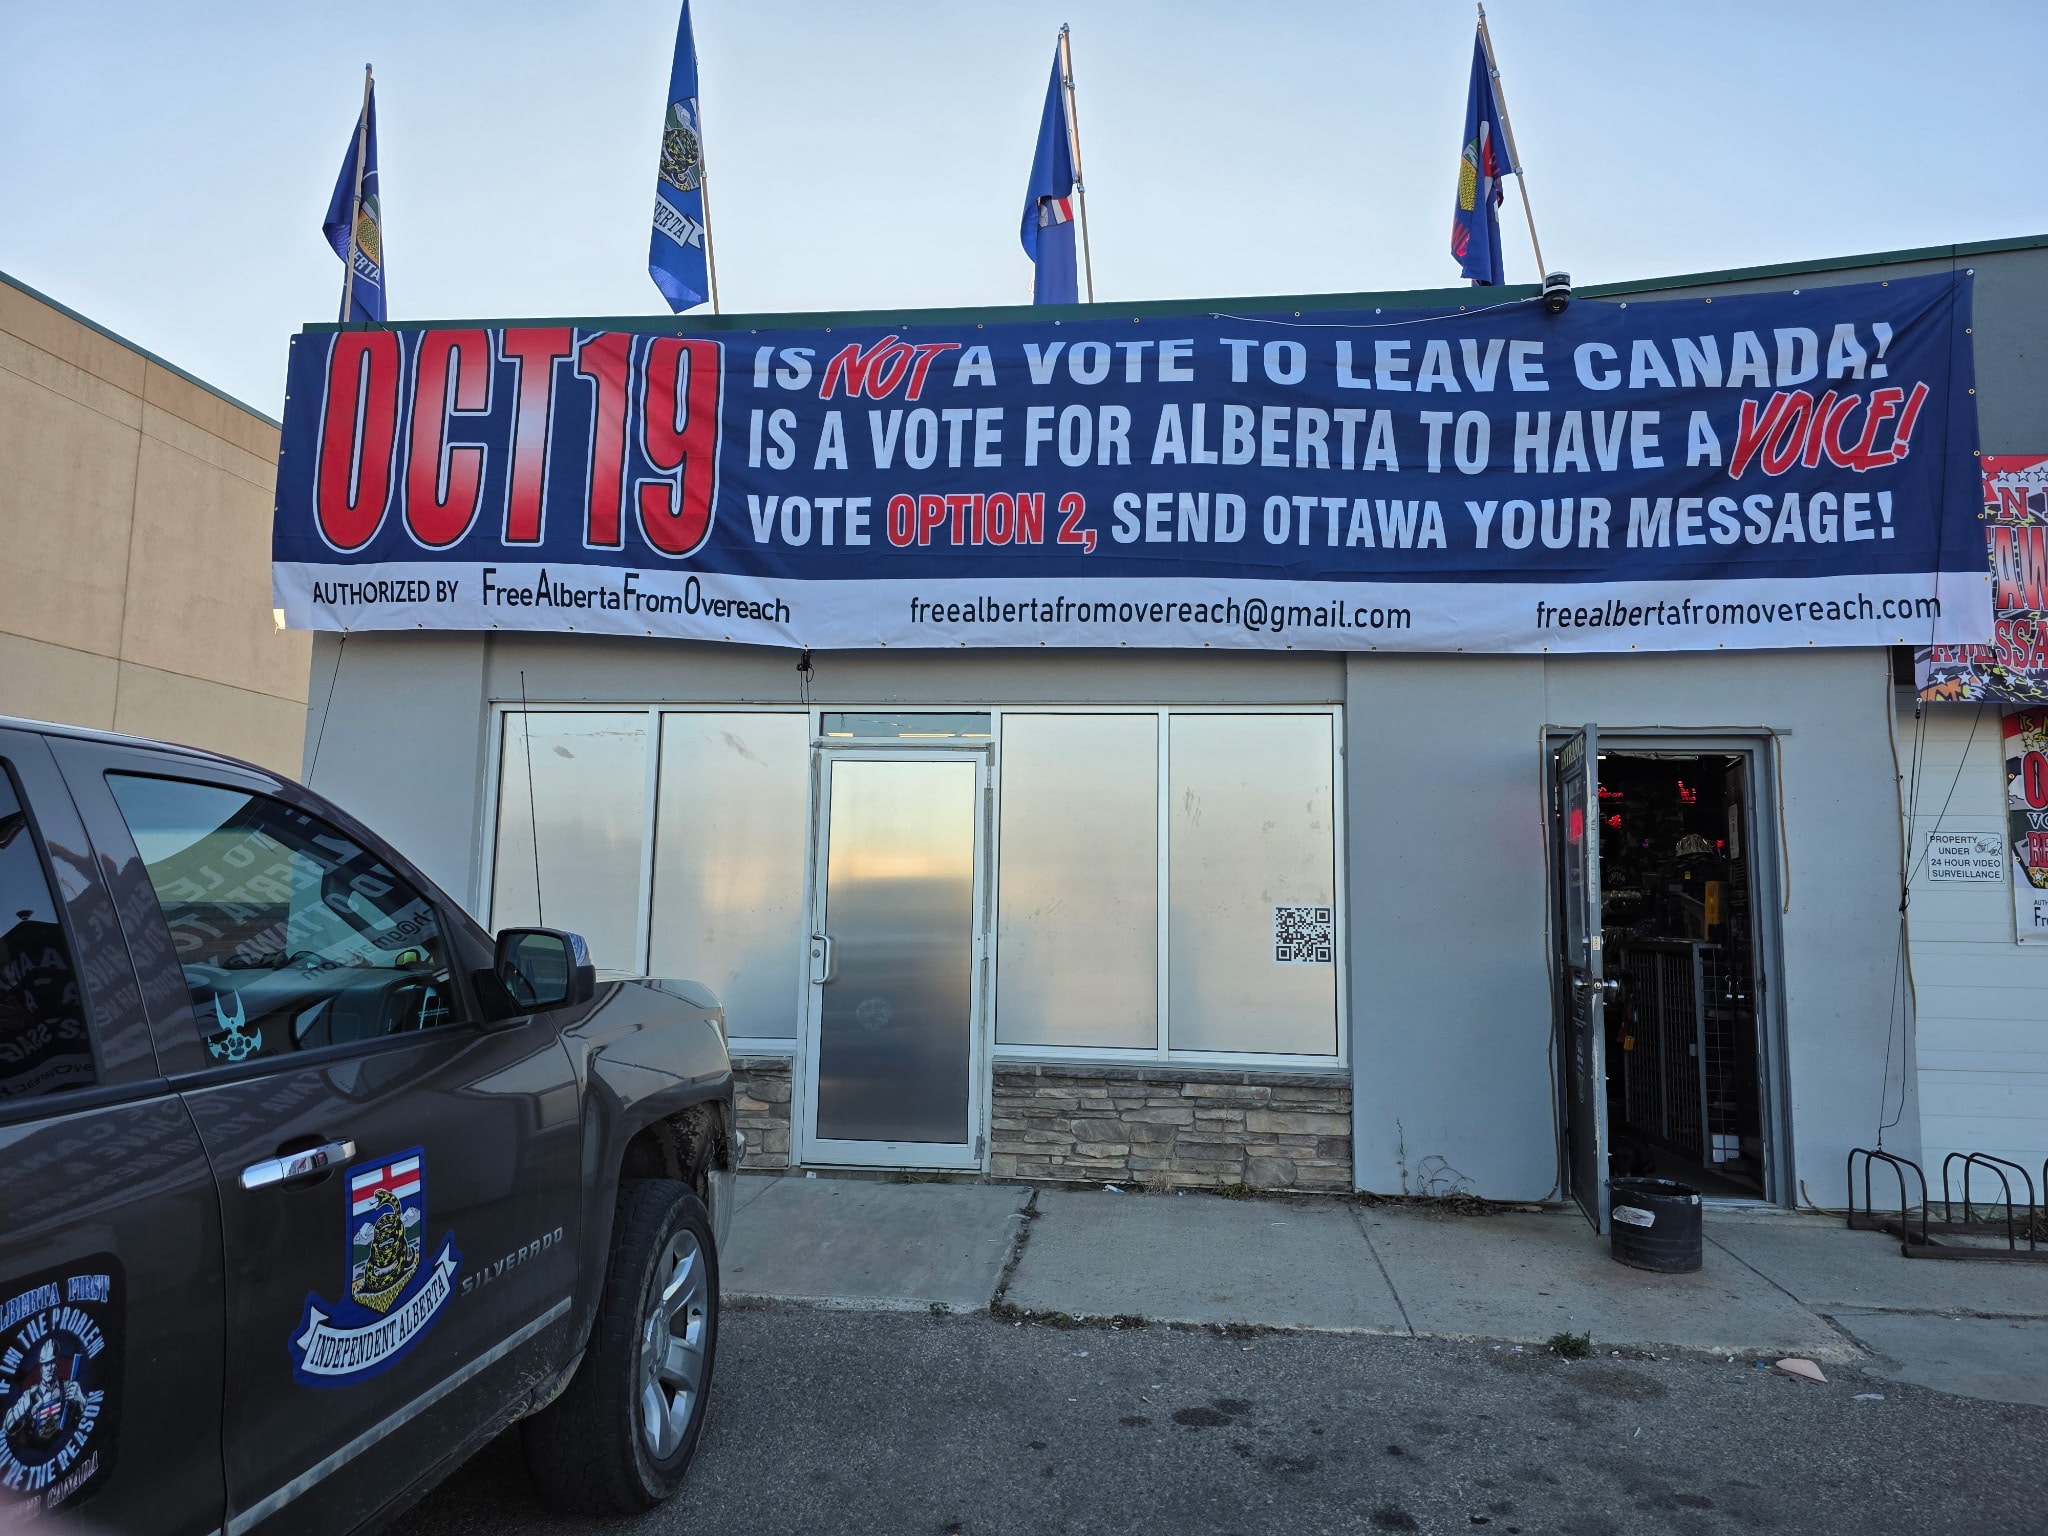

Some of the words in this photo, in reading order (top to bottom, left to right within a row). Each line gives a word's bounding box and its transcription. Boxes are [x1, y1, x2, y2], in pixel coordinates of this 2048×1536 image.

[753, 346, 816, 390] IS
[819, 335, 961, 401] NOT
[953, 345, 997, 387] A
[1023, 338, 1194, 386] VOTE
[1219, 338, 1306, 385] TO
[1335, 339, 1549, 392] LEAVE
[1573, 322, 1893, 391] CANADA!
[749, 408, 797, 470] IS
[814, 410, 848, 470] A
[868, 407, 1004, 470] VOTE
[1024, 404, 1132, 467] FOR
[1150, 403, 1400, 472] ALBERTA
[1420, 410, 1491, 474] TO
[1513, 410, 1664, 473] HAVE
[1686, 410, 1721, 466] A
[1728, 380, 1929, 480] VOICE!
[747, 494, 871, 546] VOTE
[886, 492, 1045, 547] OPTION
[1057, 492, 1097, 554] 2,
[1111, 492, 1246, 544] SEND
[1263, 495, 1447, 549] OTTAWA
[1464, 497, 1610, 549] YOUR
[1626, 491, 1894, 549] MESSAGE!
[313, 580, 430, 605] AUTHORIZED
[435, 580, 459, 603] BY
[482, 568, 791, 624] FreeAlbertaFromOvereach
[910, 597, 1412, 632] freealbertafromovereach@gmail.com
[1536, 593, 1942, 630] freealbertafromovereach.com
[1930, 836, 1977, 844] PROPERTY
[1931, 859, 1941, 867] 24
[1944, 859, 1970, 867] HOUR
[1972, 859, 2000, 868] VIDEO
[1938, 847, 1970, 855] UNDER
[1932, 869, 2000, 879] SURVEILLANCE
[461, 1226, 563, 1296] SILVERADO
[68, 1275, 110, 1302] FIRST
[17, 1312, 48, 1350] THE
[52, 1306, 105, 1359] PROBLEM
[310, 1325, 397, 1368] INDEPENDENT
[400, 1274, 446, 1340] ALBERTA
[57, 1389, 105, 1472] REASON
